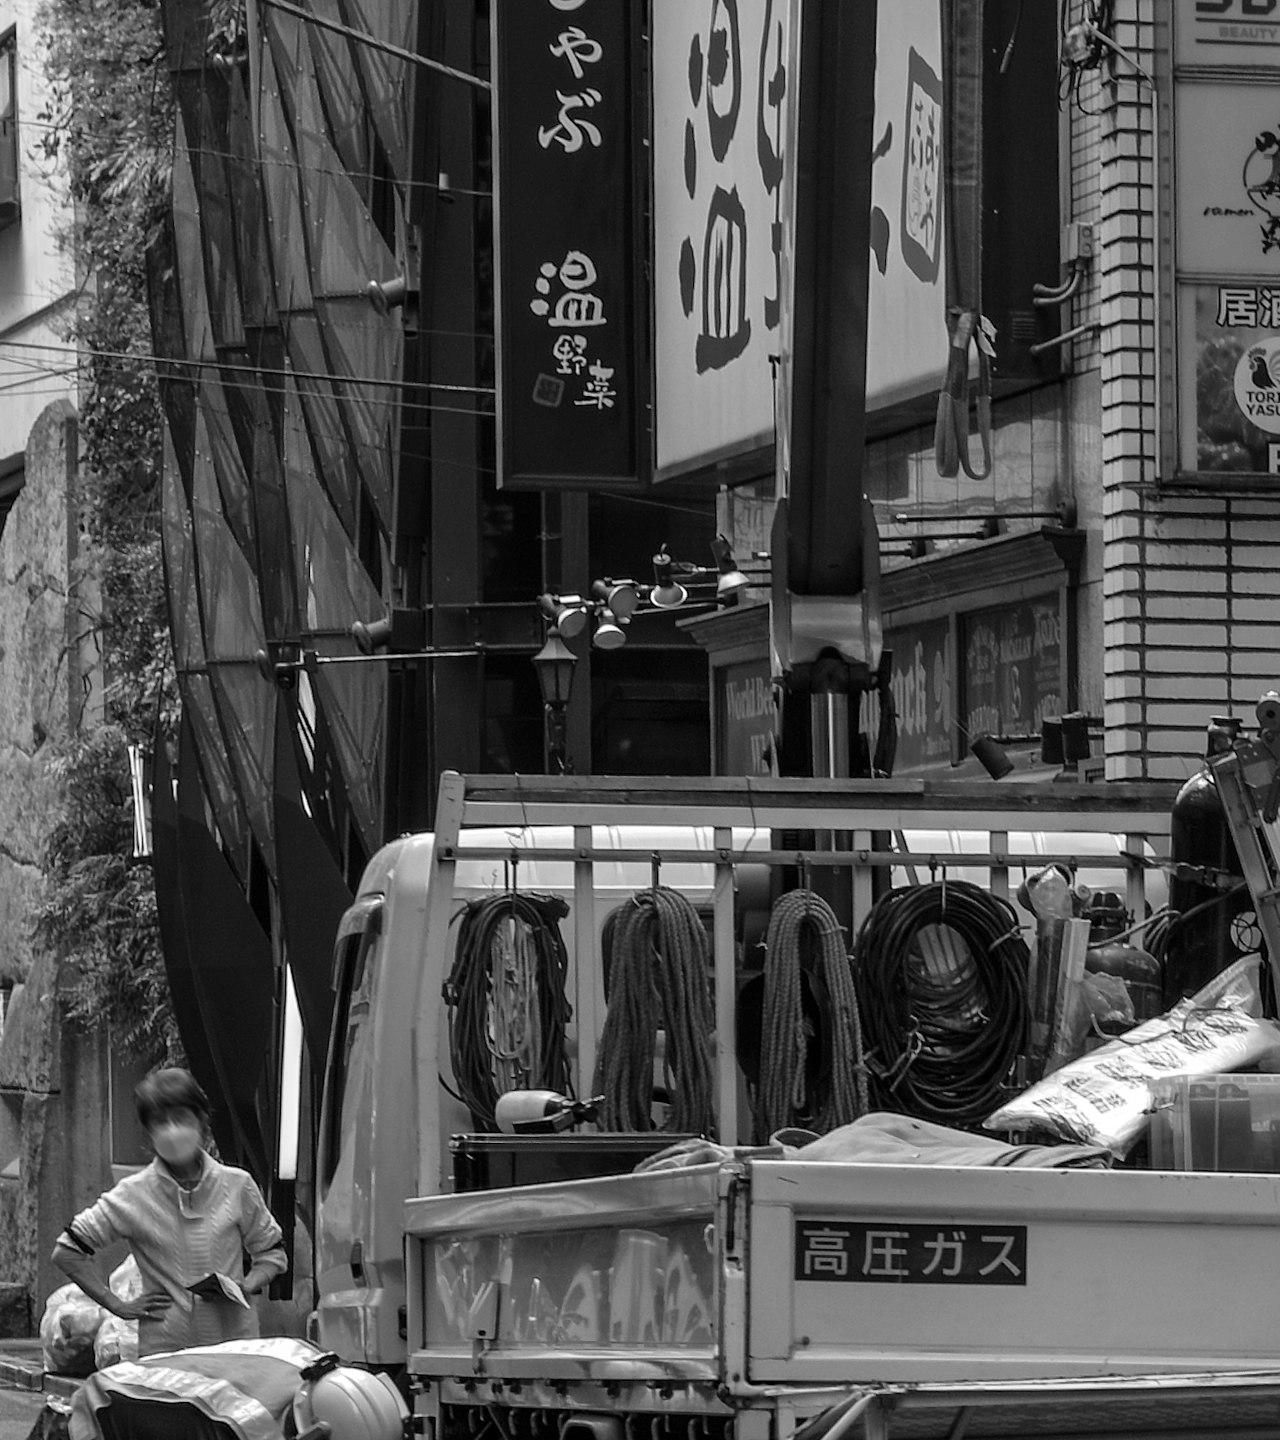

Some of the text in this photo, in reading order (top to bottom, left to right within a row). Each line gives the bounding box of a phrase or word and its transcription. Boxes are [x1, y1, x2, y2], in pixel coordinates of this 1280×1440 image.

[538, 0, 604, 154] ゃぶ
[1219, 26, 1278, 40] BEAUTY
[530, 249, 618, 411] 温野菜
[803, 1227, 1022, 1277] 高圧ガス
